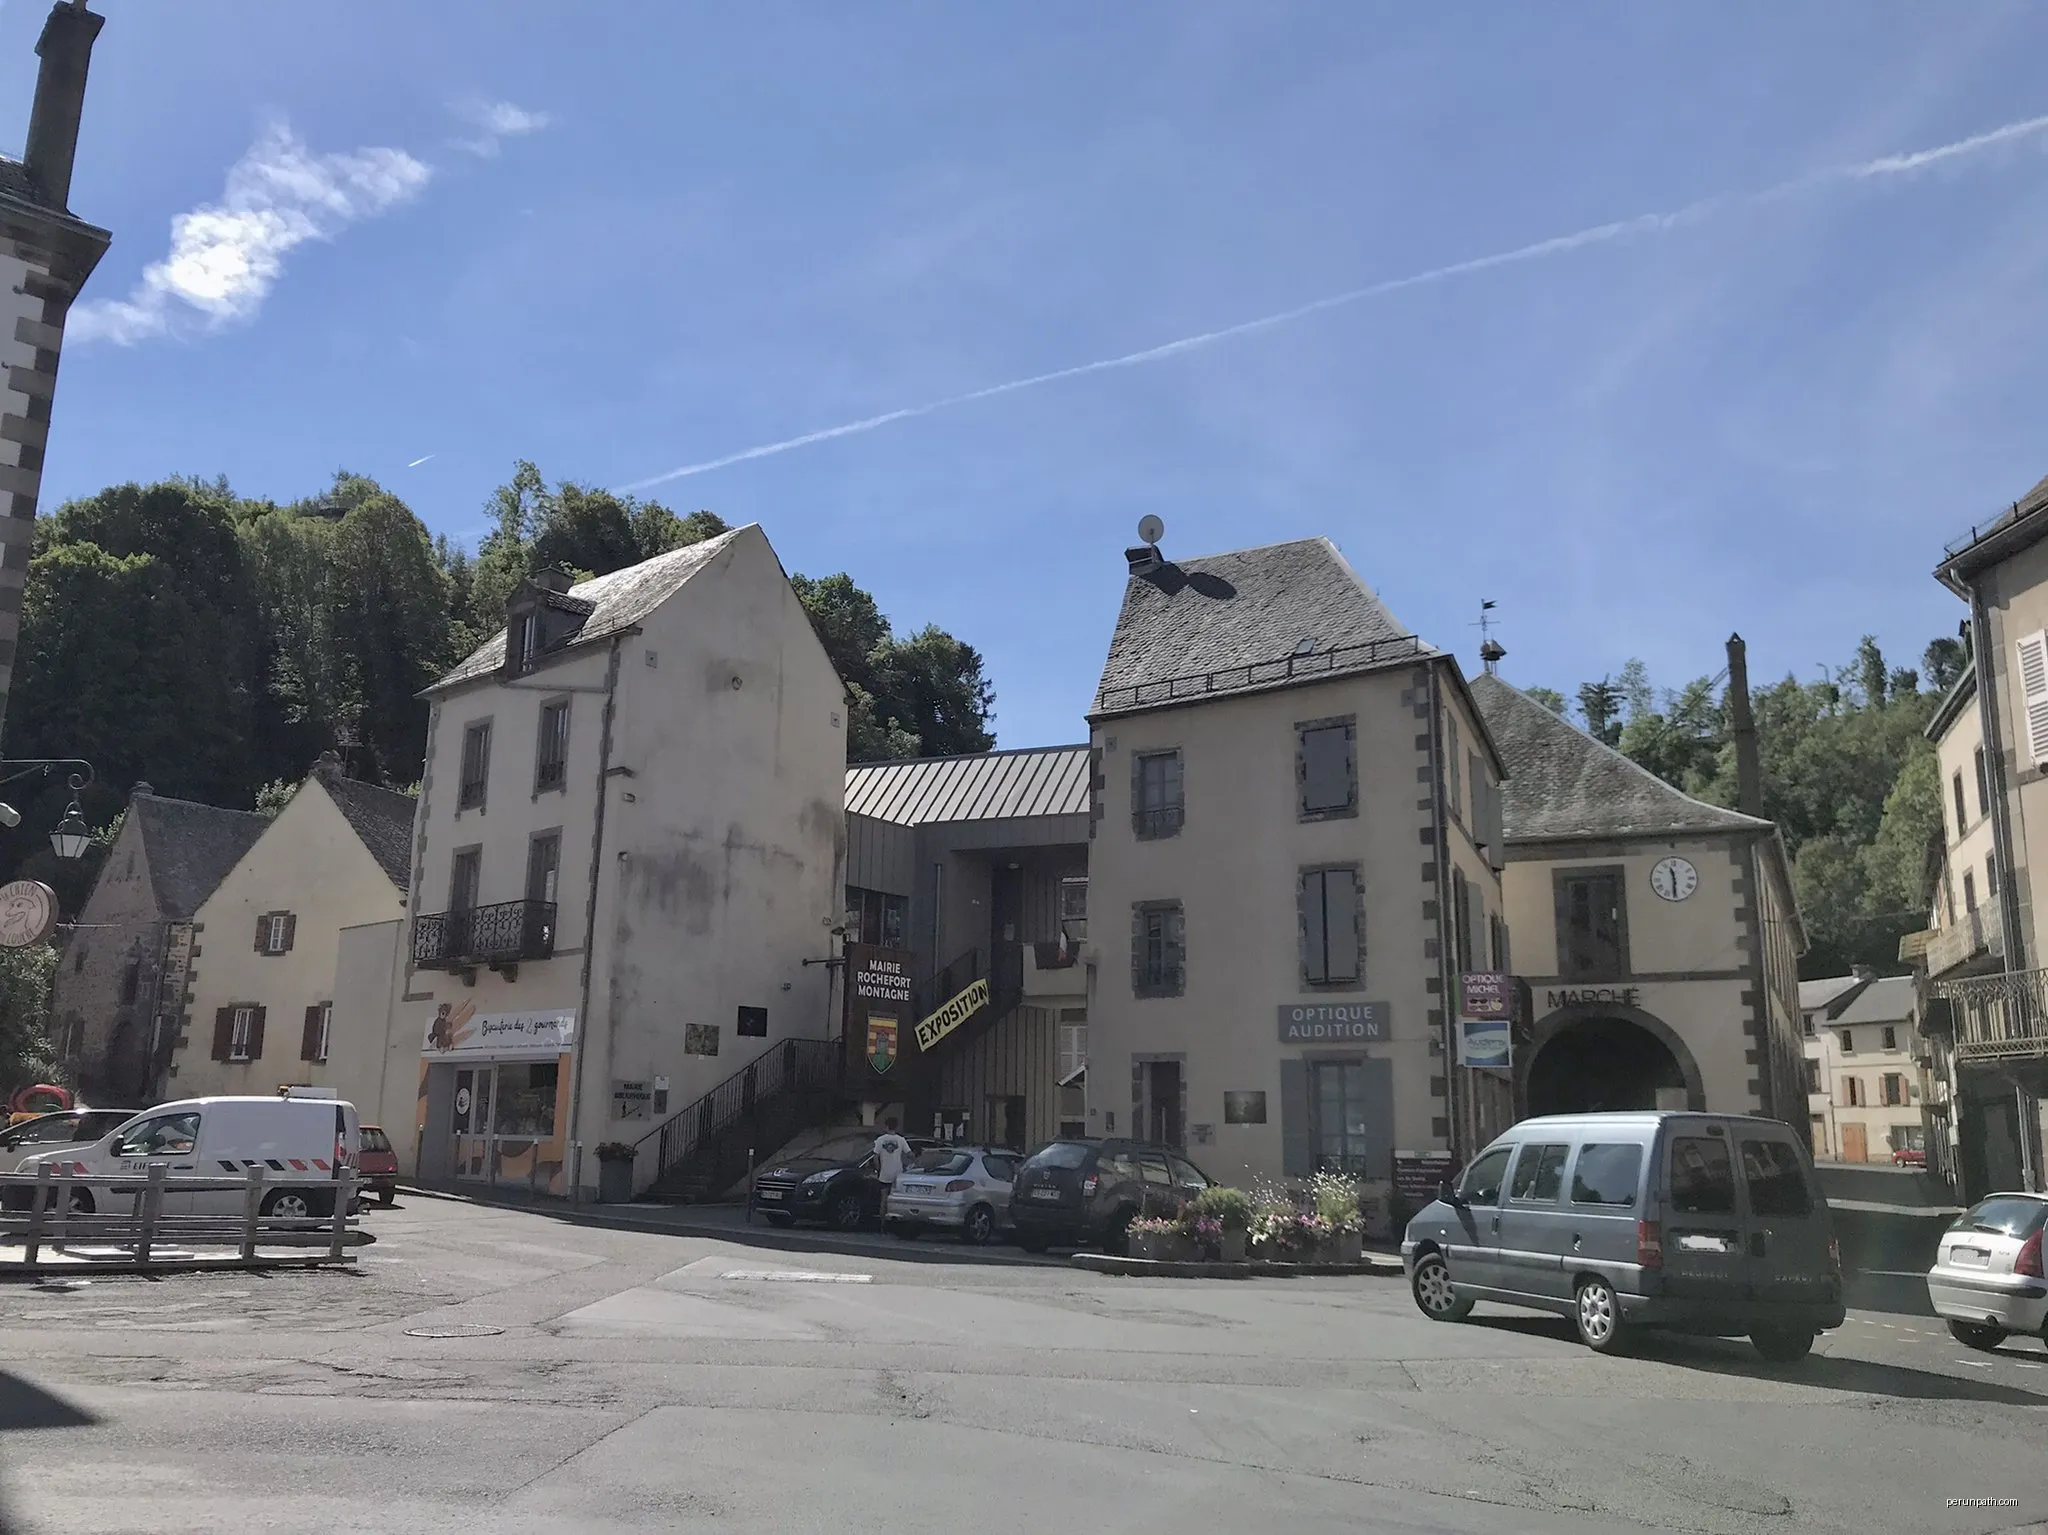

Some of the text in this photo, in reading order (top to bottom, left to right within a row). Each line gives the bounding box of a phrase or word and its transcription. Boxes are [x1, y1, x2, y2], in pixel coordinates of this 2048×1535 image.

[869, 960, 901, 974] MAIRIE
[857, 971, 911, 989] ROCHEFORT
[1462, 974, 1505, 985] OPTIQUE
[858, 985, 910, 1001] MONTAGNE
[1467, 985, 1500, 994] MICHEL
[917, 983, 988, 1046] EXPOSITION
[1292, 1006, 1373, 1021] OPTIQUE
[1289, 1023, 1379, 1037] AUDITION
